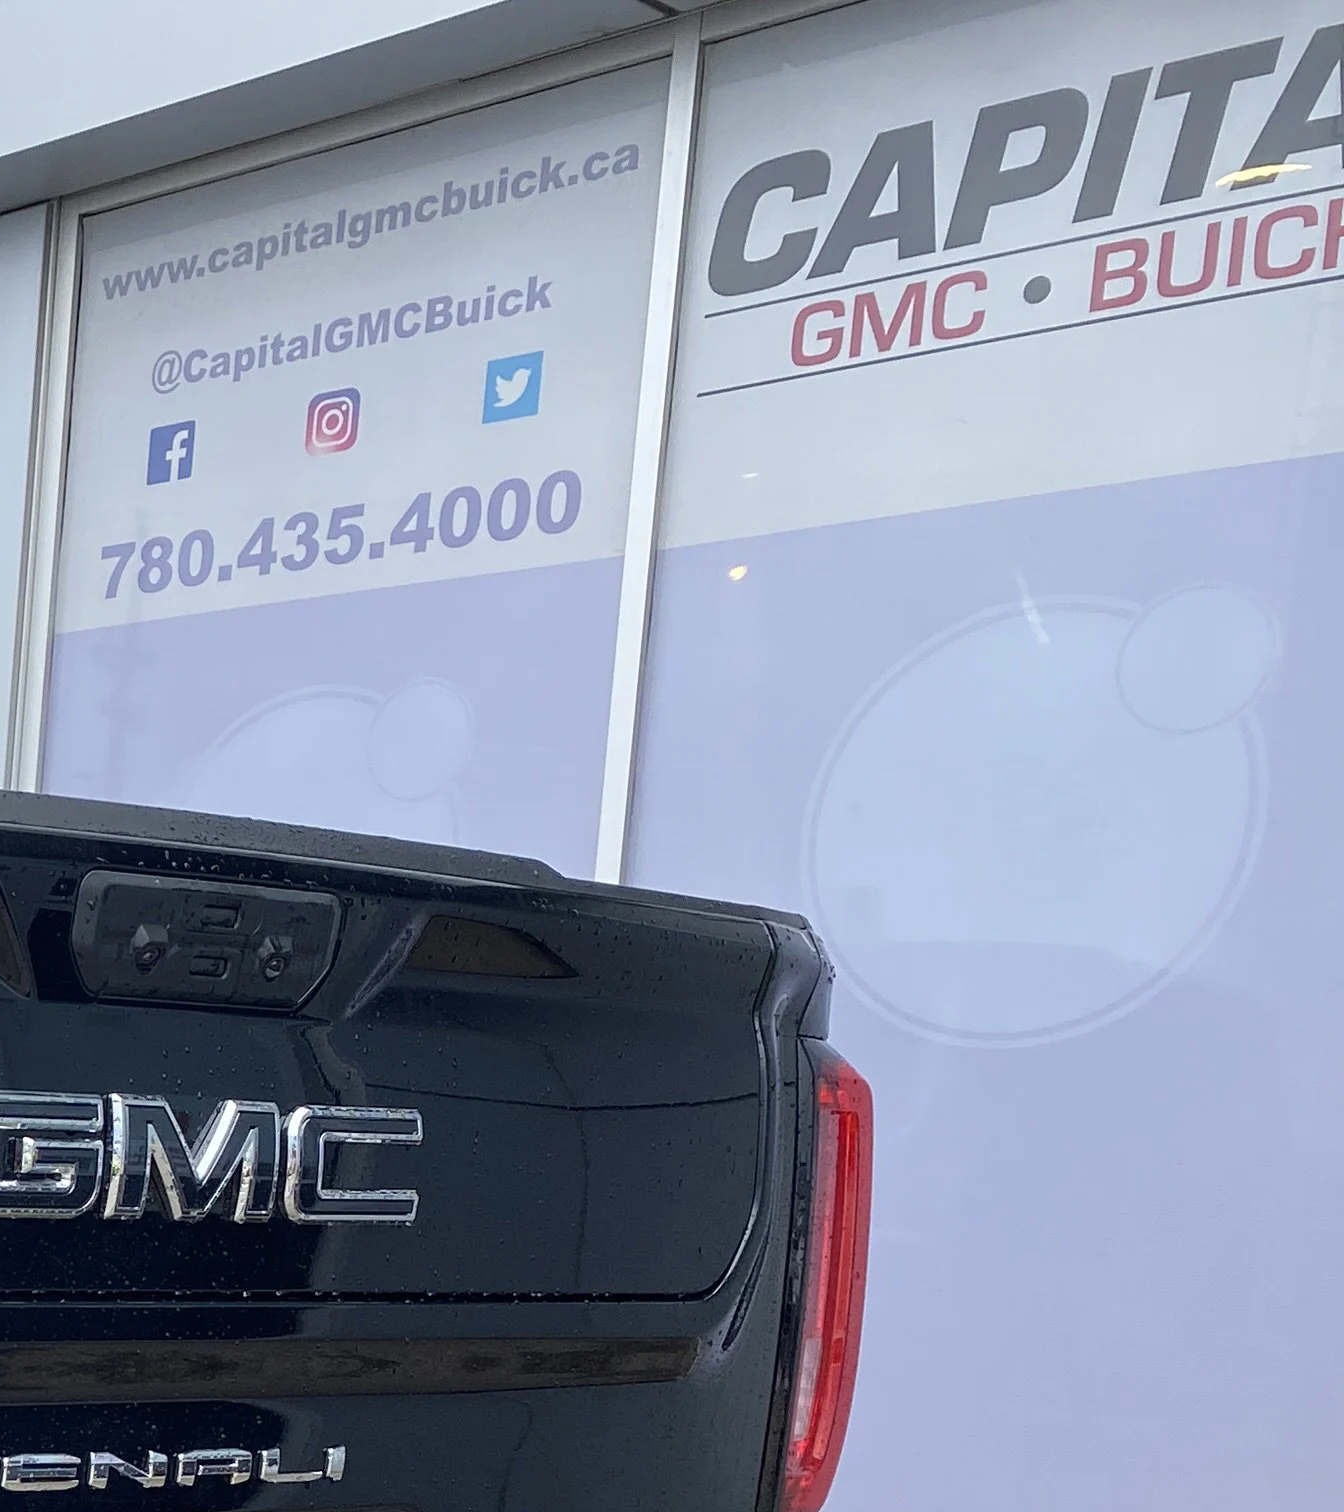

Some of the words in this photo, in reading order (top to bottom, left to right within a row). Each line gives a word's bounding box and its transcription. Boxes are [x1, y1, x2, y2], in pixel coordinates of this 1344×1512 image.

[102, 142, 640, 301] www.capitalgmcbuick.ca
[708, 22, 1344, 297] CAPITA
[151, 276, 553, 394] @CapitalGMCBuick
[791, 269, 988, 367] GMC
[100, 469, 582, 600] 780.435.4000
